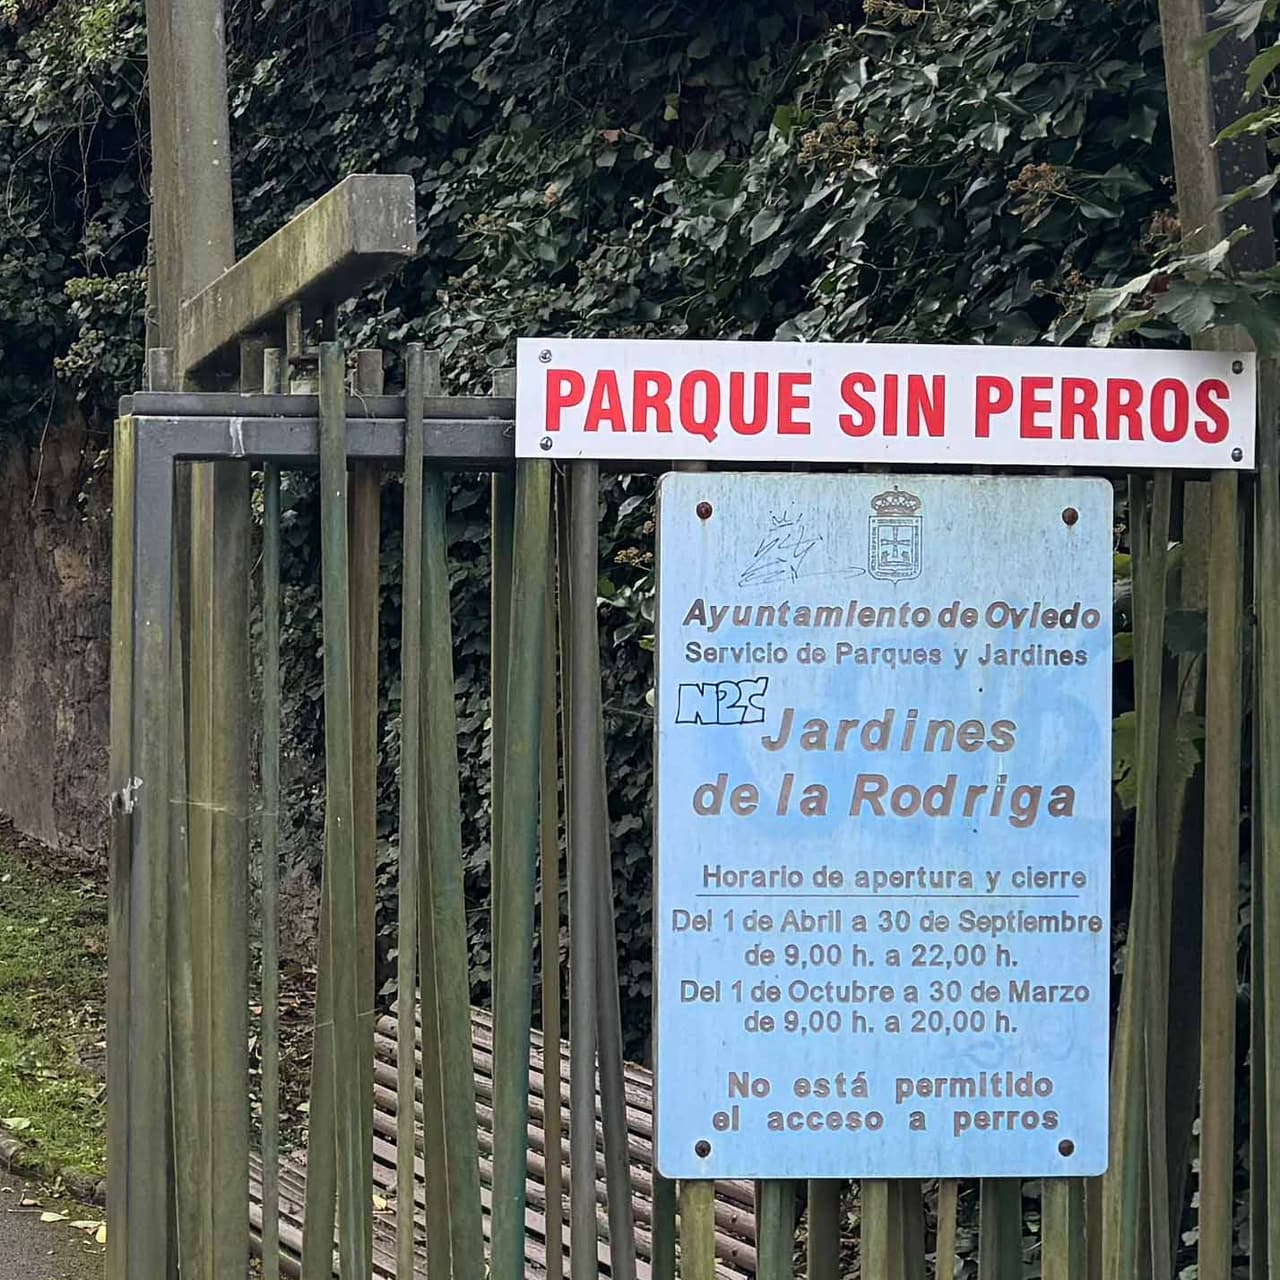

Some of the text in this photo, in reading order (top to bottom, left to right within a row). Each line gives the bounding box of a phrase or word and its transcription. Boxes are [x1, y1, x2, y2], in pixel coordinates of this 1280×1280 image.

[545, 369, 1230, 444] PARQUE SIN PERROS
[683, 599, 1100, 632] Ayuntamiento de Oviedo
[686, 641, 1088, 669] Servicio de Parques y Jardines
[762, 708, 1017, 752] Jardines
[692, 773, 1076, 828] de la Rodriga
[703, 865, 1087, 894] Horario de apertura y cierre
[672, 909, 1103, 938] Del 1 de Abril a 30 de Septiembre
[744, 943, 1018, 970] de 9,00 h. a 22,00 h.
[680, 981, 1090, 1004] Del 1 de Octubre a 30 de Marzo
[744, 1010, 1018, 1037] de 9,00 h. a 20,00 h.
[728, 1072, 1054, 1104] No está permitido
[712, 1106, 1059, 1137] el acceso a perros
